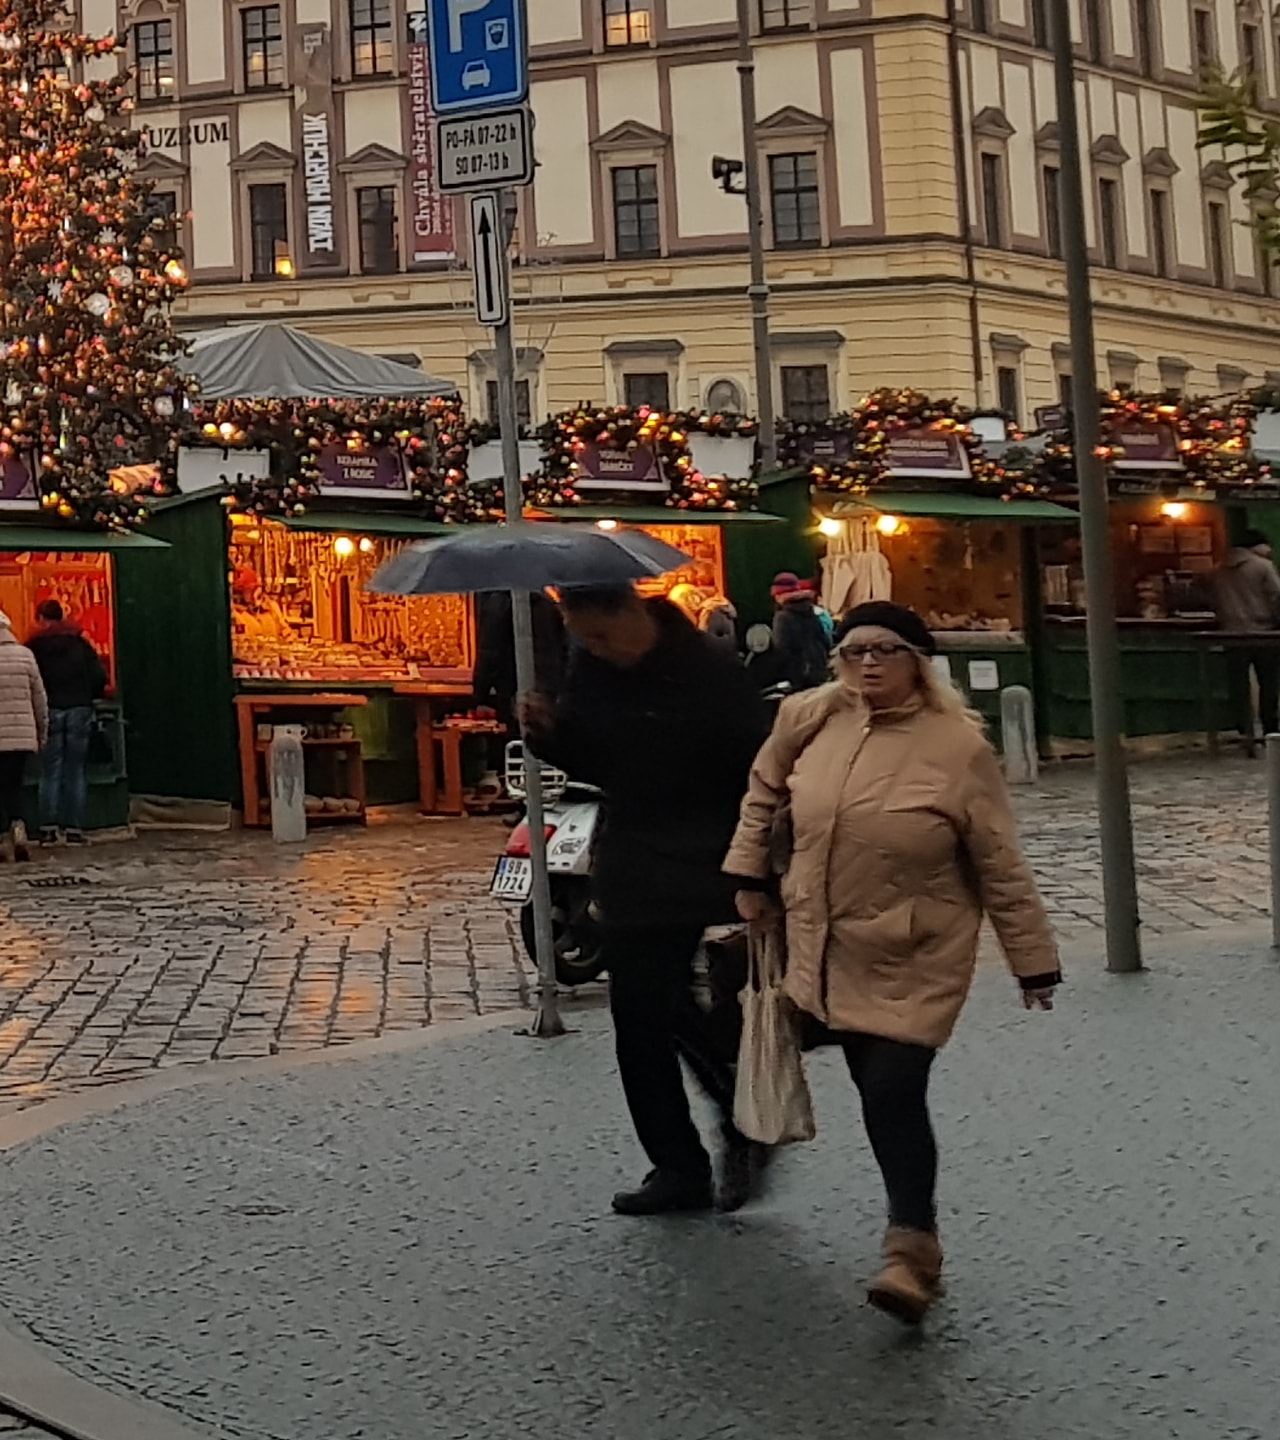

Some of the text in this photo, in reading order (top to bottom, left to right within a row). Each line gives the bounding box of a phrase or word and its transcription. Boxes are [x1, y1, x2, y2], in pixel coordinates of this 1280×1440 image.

[446, 122, 517, 150] PO-PÁ 07-22 h
[302, 112, 334, 253] IVAN MARCHUK
[456, 151, 509, 175] SO 07-13 h
[413, 169, 431, 236] Chvála
